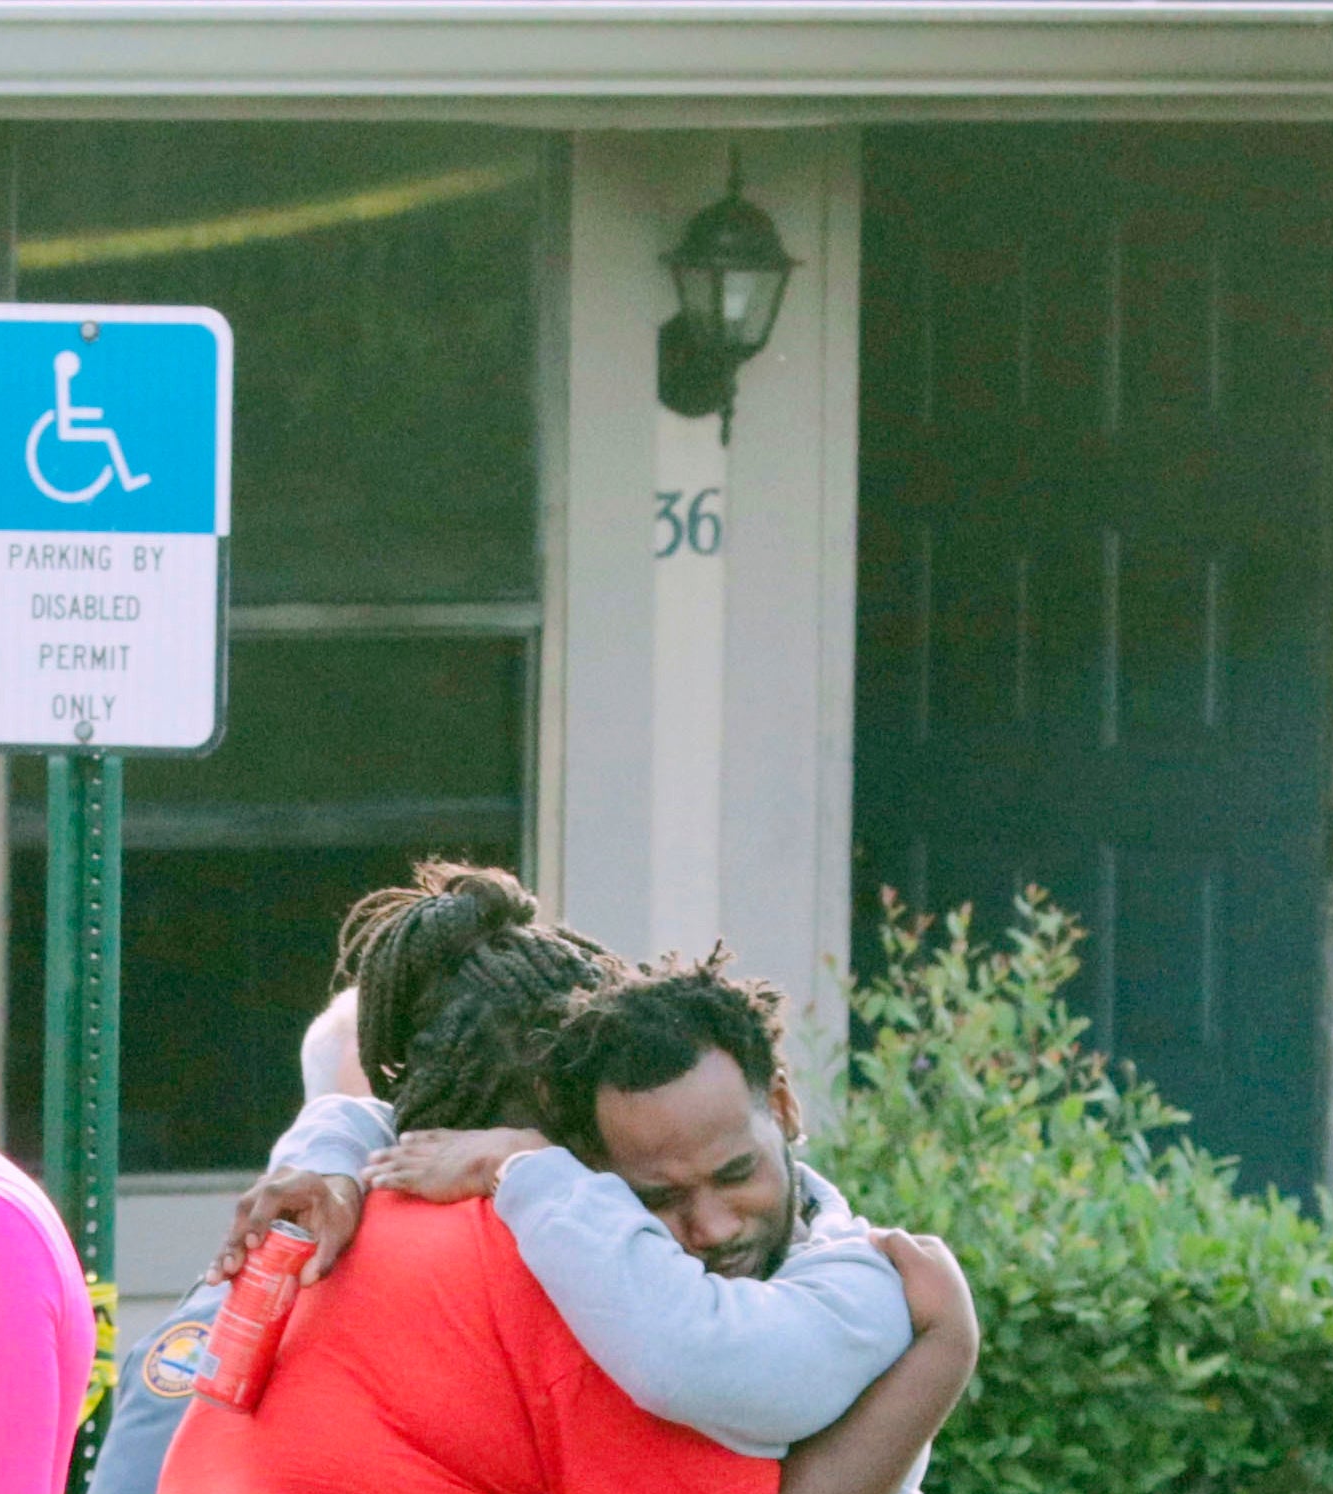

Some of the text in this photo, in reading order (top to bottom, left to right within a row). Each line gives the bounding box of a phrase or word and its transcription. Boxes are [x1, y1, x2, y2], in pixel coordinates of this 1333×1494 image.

[654, 487, 722, 559] 36
[8, 543, 165, 572] PARKING BY
[31, 594, 141, 621] DISABLED
[39, 644, 130, 671] PERMIT
[52, 695, 116, 721] ONLY
